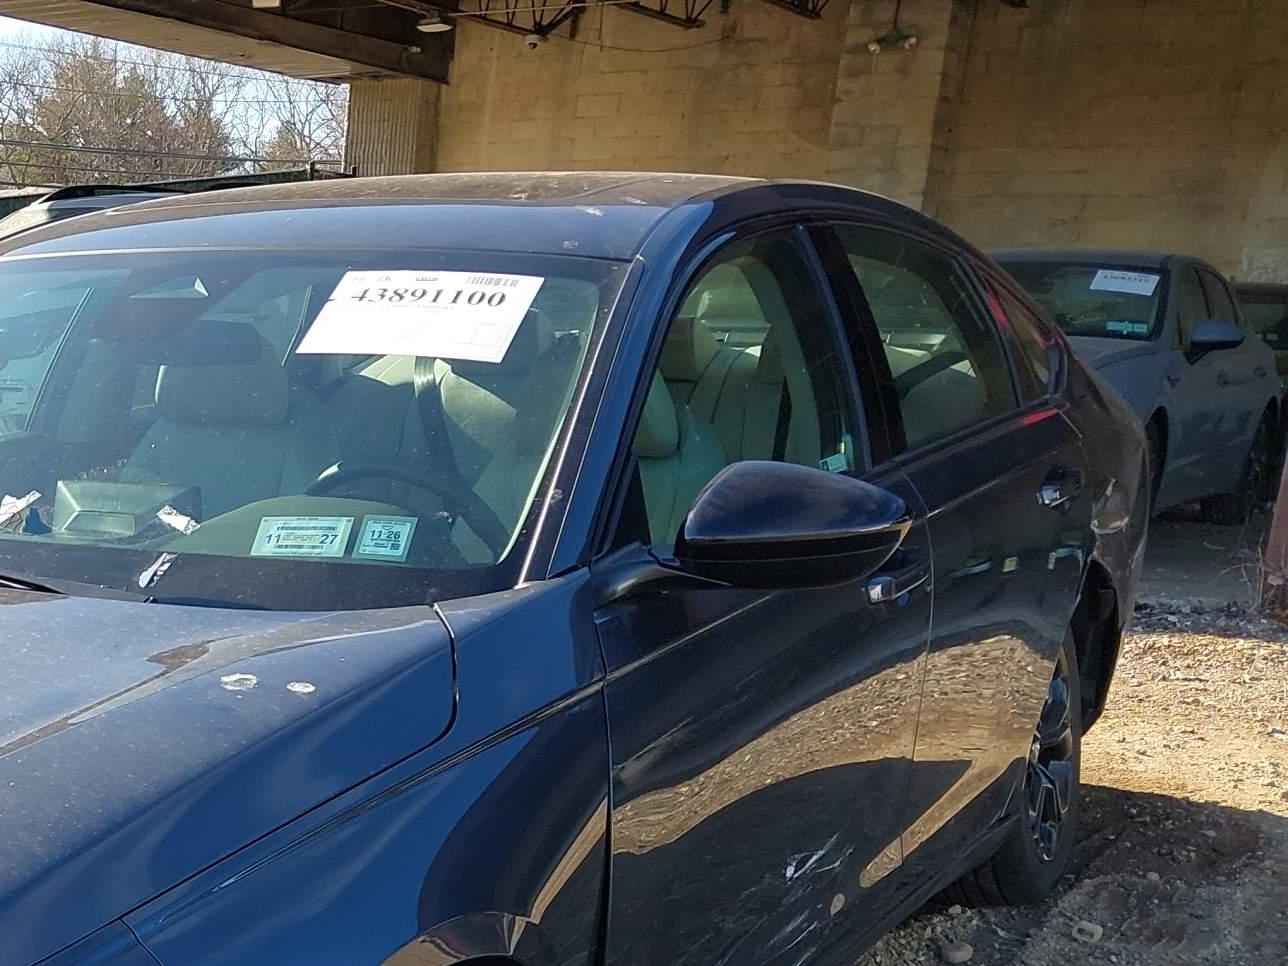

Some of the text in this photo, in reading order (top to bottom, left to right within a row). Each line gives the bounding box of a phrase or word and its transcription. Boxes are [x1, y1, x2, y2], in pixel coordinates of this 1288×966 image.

[350, 286, 508, 308] 43891100
[265, 533, 282, 545] 11
[318, 533, 340, 545] 27
